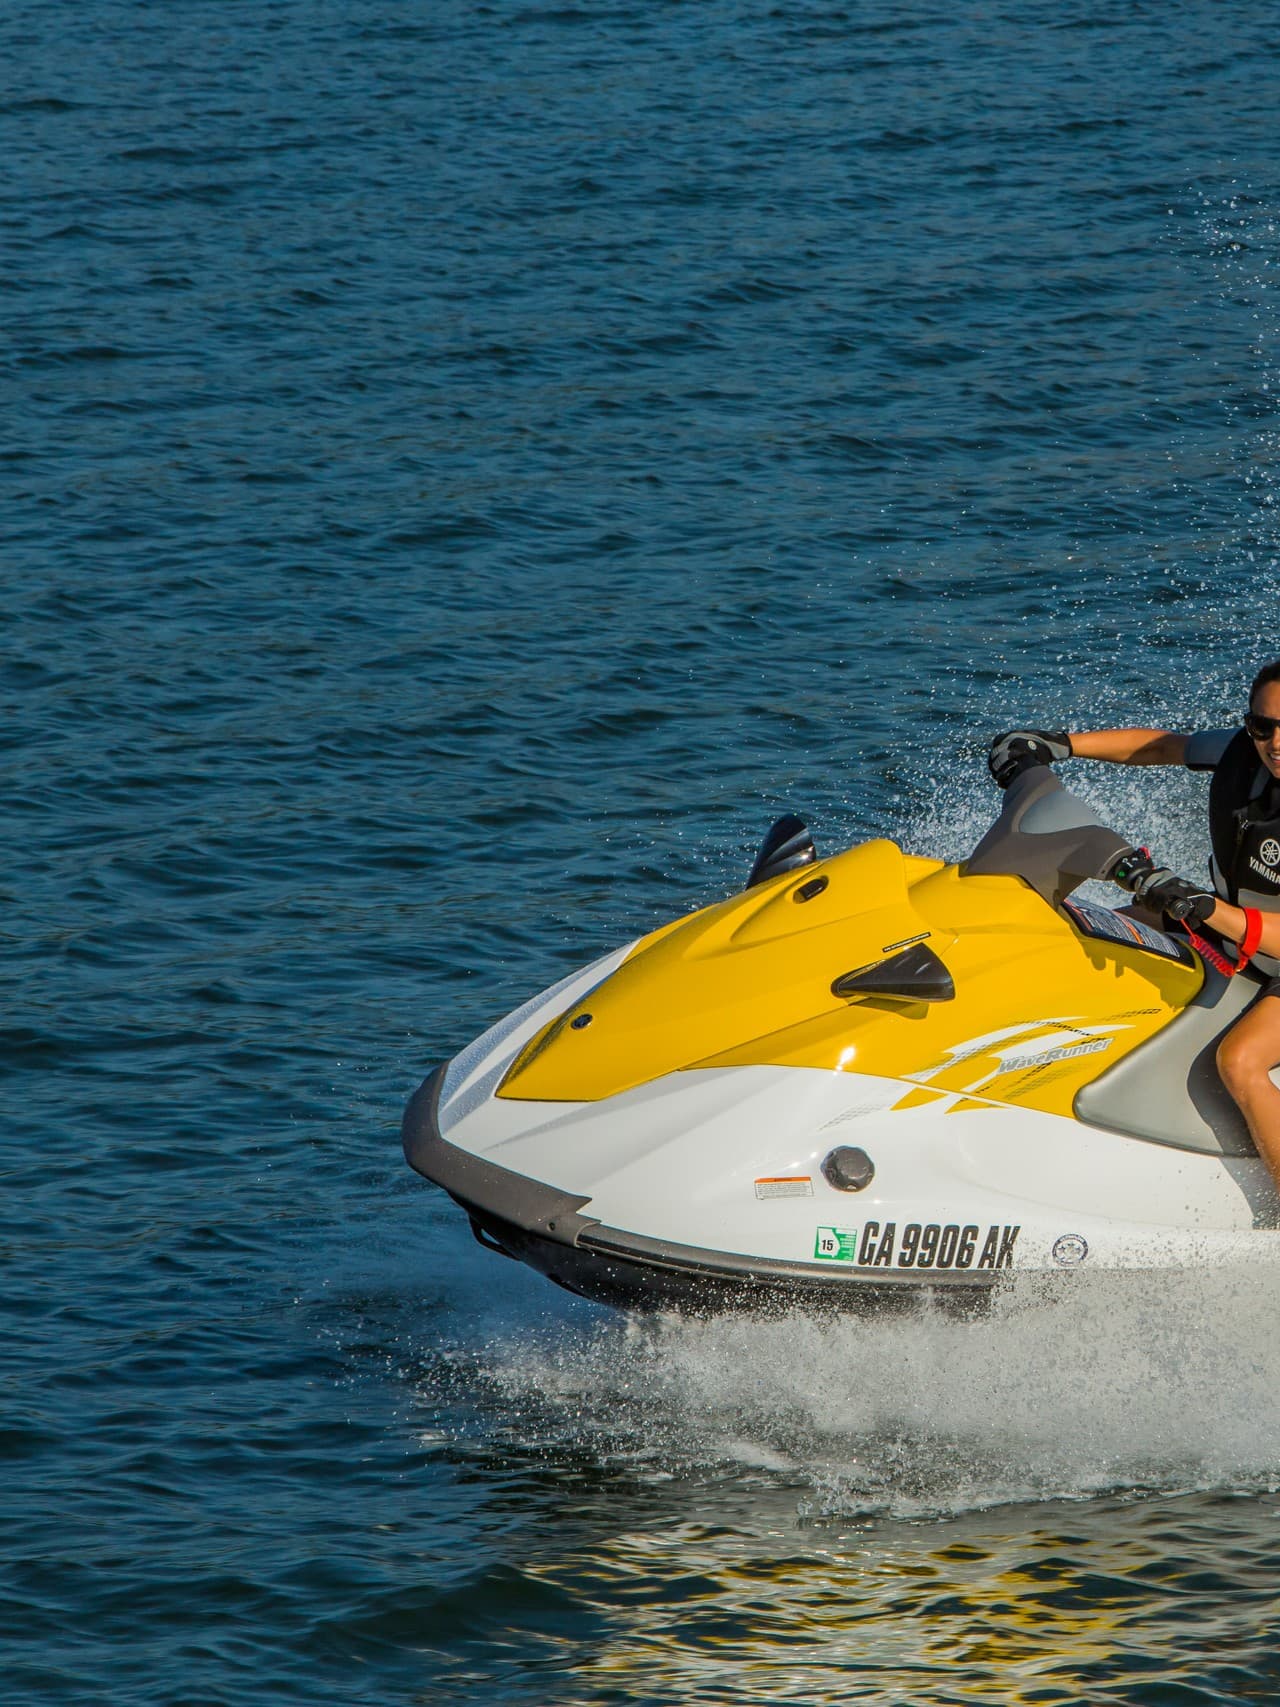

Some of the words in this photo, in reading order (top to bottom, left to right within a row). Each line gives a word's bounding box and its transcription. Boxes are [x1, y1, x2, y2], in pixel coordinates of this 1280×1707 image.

[998, 1038, 1112, 1073] WaveRunner
[821, 1239, 834, 1251] 15
[858, 1221, 896, 1267] GA
[898, 1223, 980, 1269] 9906
[977, 1225, 1021, 1269] AK
